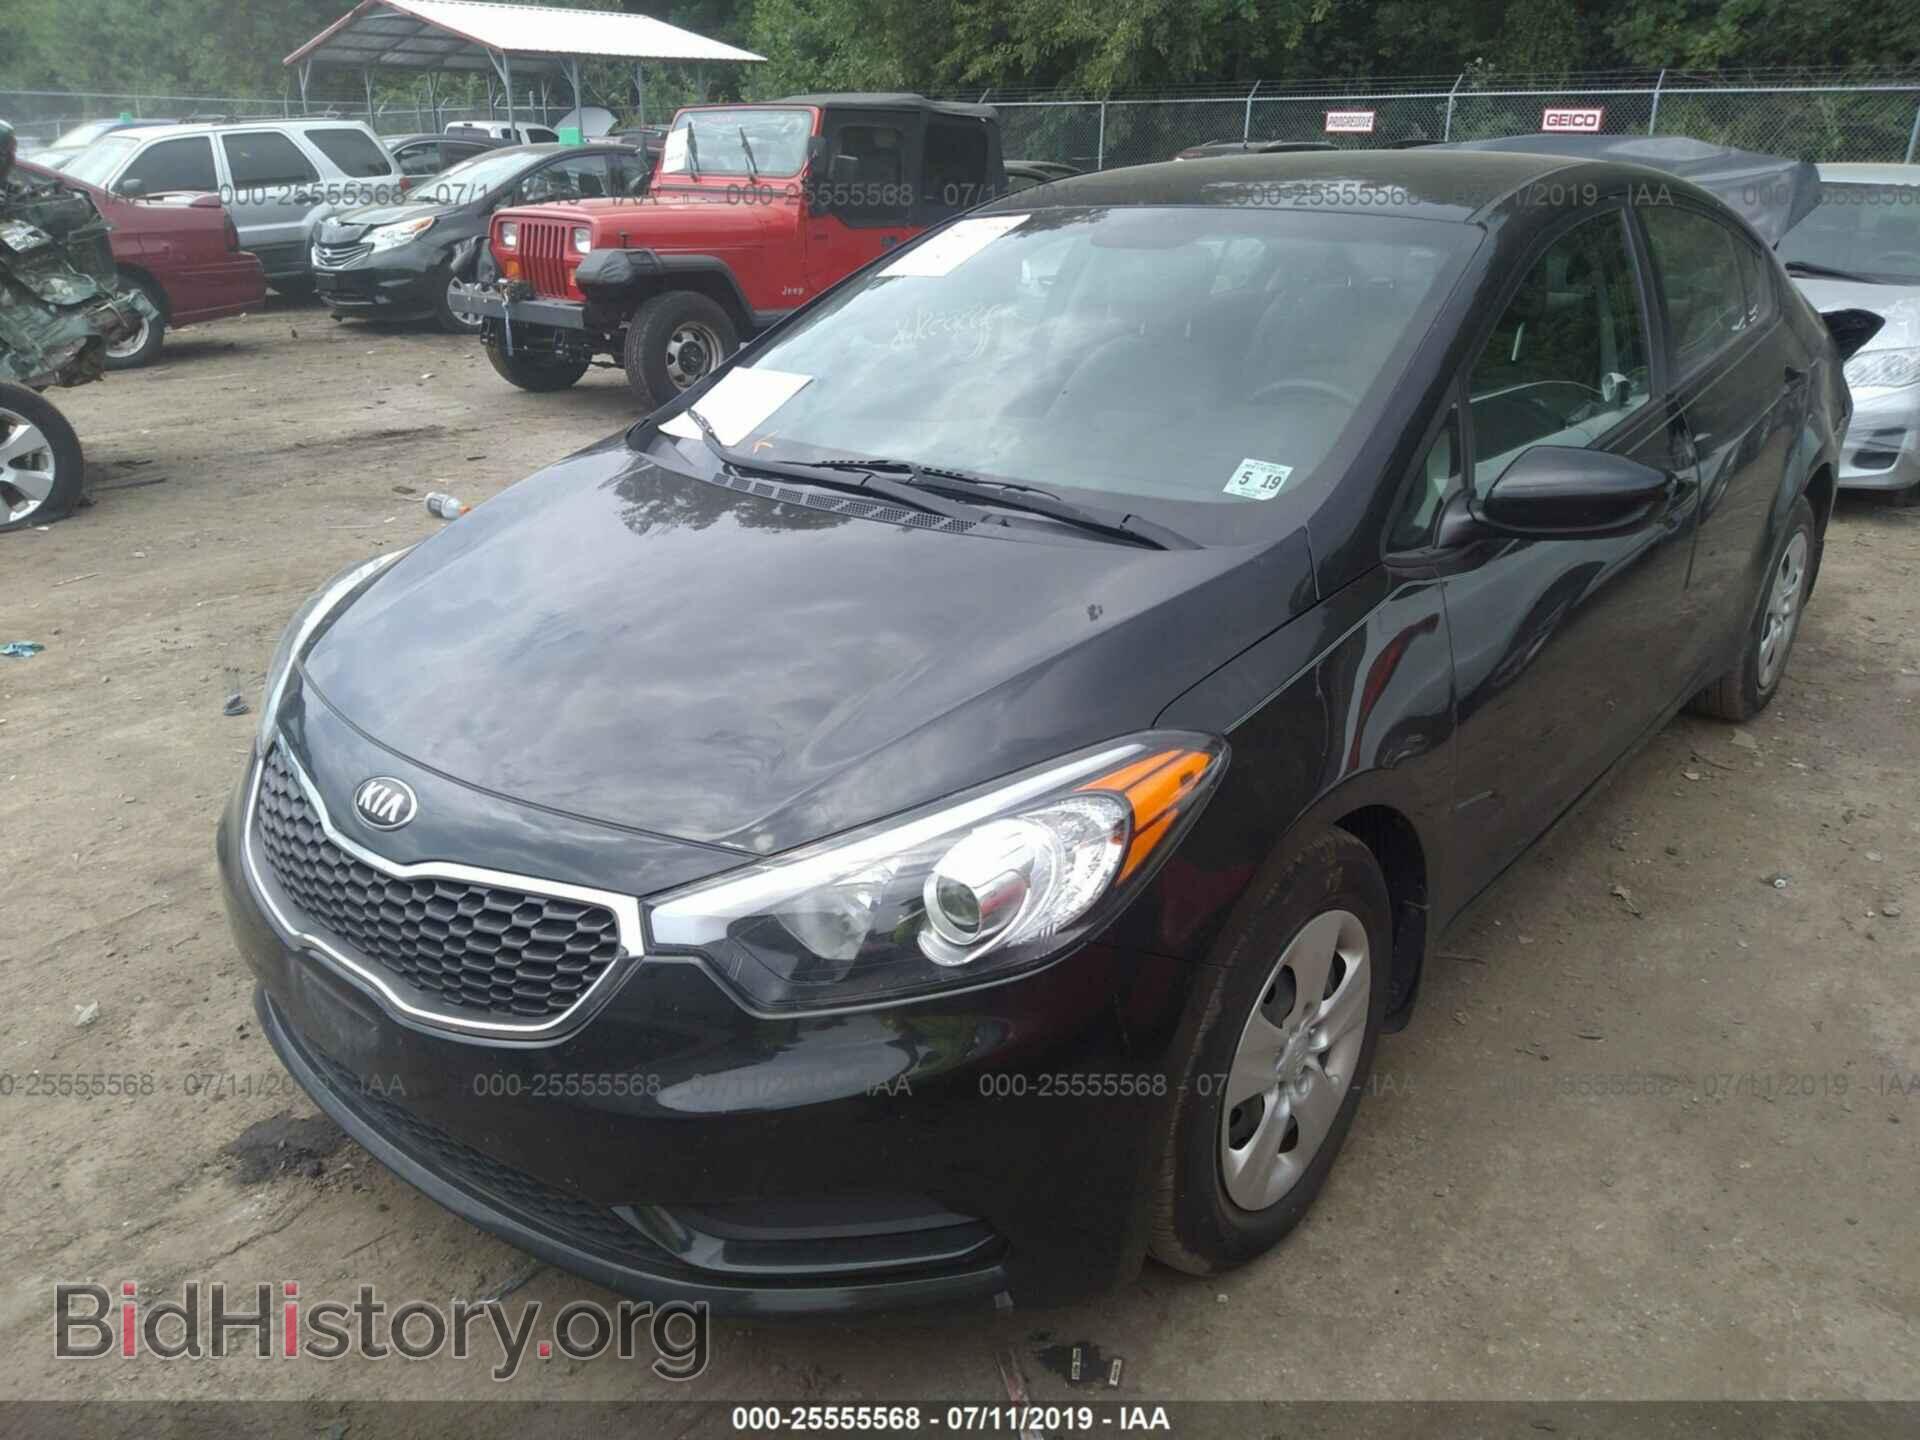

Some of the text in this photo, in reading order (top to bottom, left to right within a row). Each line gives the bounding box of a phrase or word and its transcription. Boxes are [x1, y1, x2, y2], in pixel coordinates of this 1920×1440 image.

[1546, 113, 1597, 127] GEICO
[1238, 470, 1283, 490] 5 19
[358, 781, 405, 823] KIA
